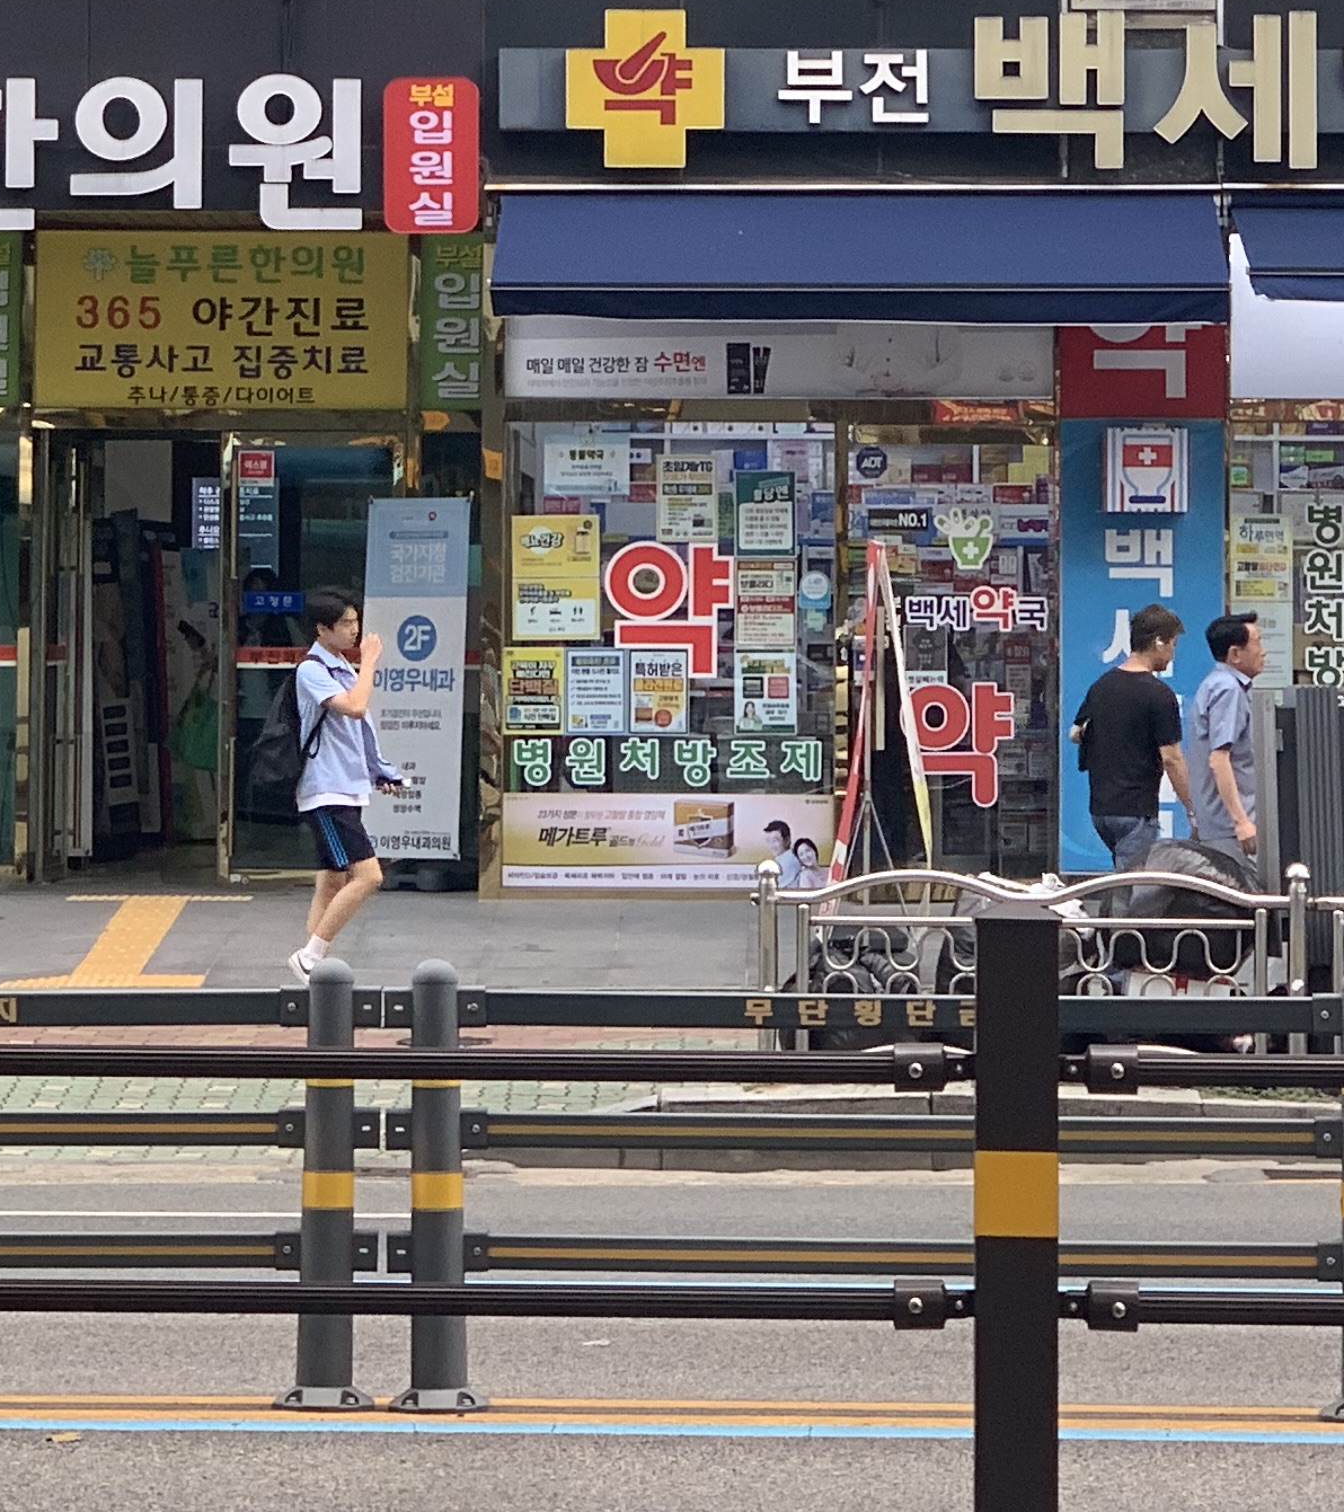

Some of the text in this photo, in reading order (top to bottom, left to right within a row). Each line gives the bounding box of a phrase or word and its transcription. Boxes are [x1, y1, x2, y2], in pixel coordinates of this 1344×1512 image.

[409, 84, 454, 106] 부설
[777, 49, 929, 125] 부전
[407, 110, 454, 227] 입원실
[124, 245, 367, 284] 늘푸른한의원
[76, 294, 370, 337] 365 야간진료
[431, 272, 481, 401] 입원실
[74, 343, 370, 379] 교통사고 집중치료
[526, 357, 554, 375] 매일
[557, 357, 585, 374] 매일
[588, 356, 631, 374] 건강한
[634, 356, 649, 373] 잠
[127, 385, 315, 406] 추나/통증/다이어트
[861, 458, 884, 469] ADT
[898, 512, 928, 527] NO.1
[390, 543, 446, 564] 국가지정
[390, 564, 446, 584] 검진기관
[606, 540, 735, 679] 약
[906, 586, 1048, 632] 백세약국
[403, 624, 431, 651] 2F
[373, 668, 455, 693] 이영우내과
[635, 661, 683, 678] 특허받은
[900, 682, 1015, 808] 약
[401, 761, 416, 771] 내과
[514, 738, 824, 787] 병원처방조제
[379, 836, 452, 851] 이영우내과의원
[539, 826, 609, 848] 메가트루
[744, 998, 976, 1027] 무단횡단금
